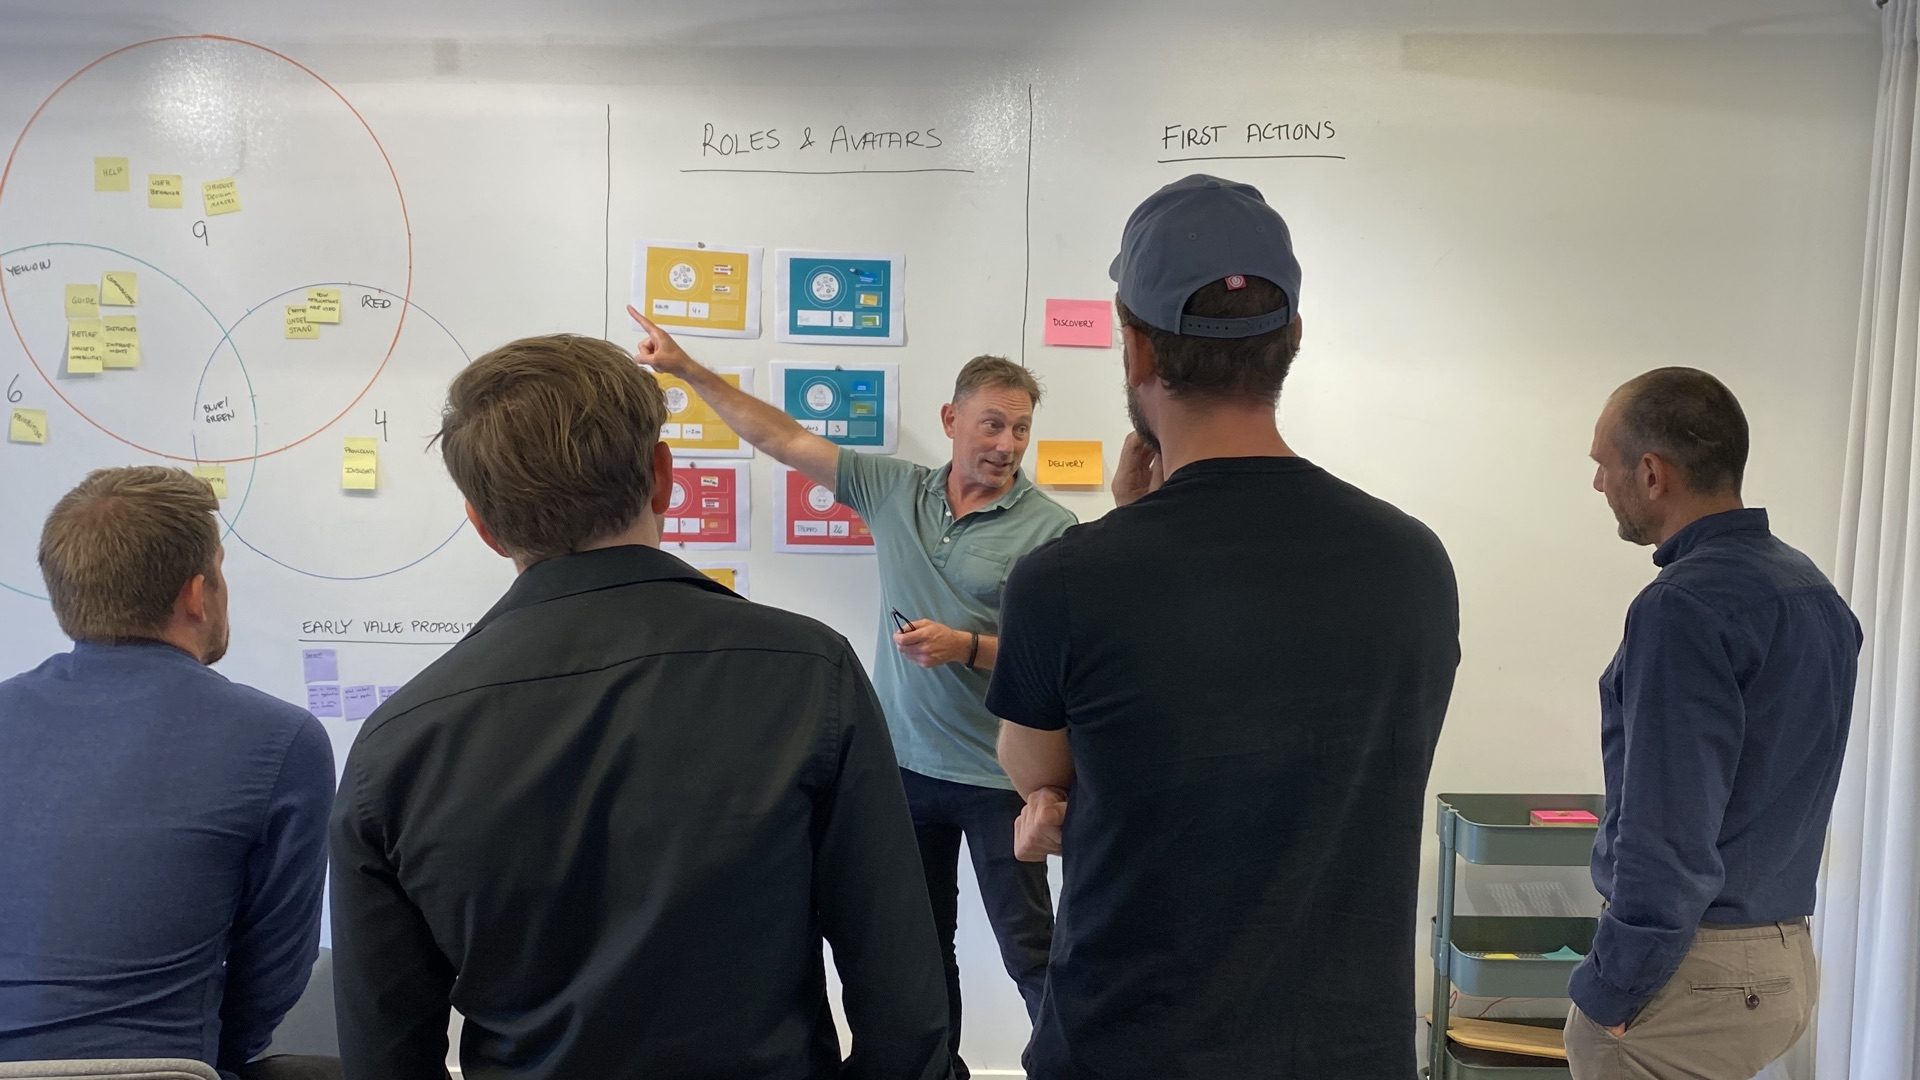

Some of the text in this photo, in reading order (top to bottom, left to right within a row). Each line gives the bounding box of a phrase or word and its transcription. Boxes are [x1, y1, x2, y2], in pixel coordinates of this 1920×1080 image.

[702, 122, 943, 156] ROLES & AVATARS
[1162, 121, 1336, 149] FIRST ACTIONS
[103, 167, 123, 177] HELP
[192, 220, 209, 247] 9
[71, 296, 97, 305] GUIDE
[361, 294, 391, 309] RED
[1053, 317, 1095, 328] DISCOVERY
[7, 373, 23, 403] 6
[205, 409, 235, 424] GREEN
[374, 408, 388, 443] 4
[1047, 459, 1085, 469] DELIVERY
[302, 619, 478, 635] EARLY VALUE PROPOSIT
